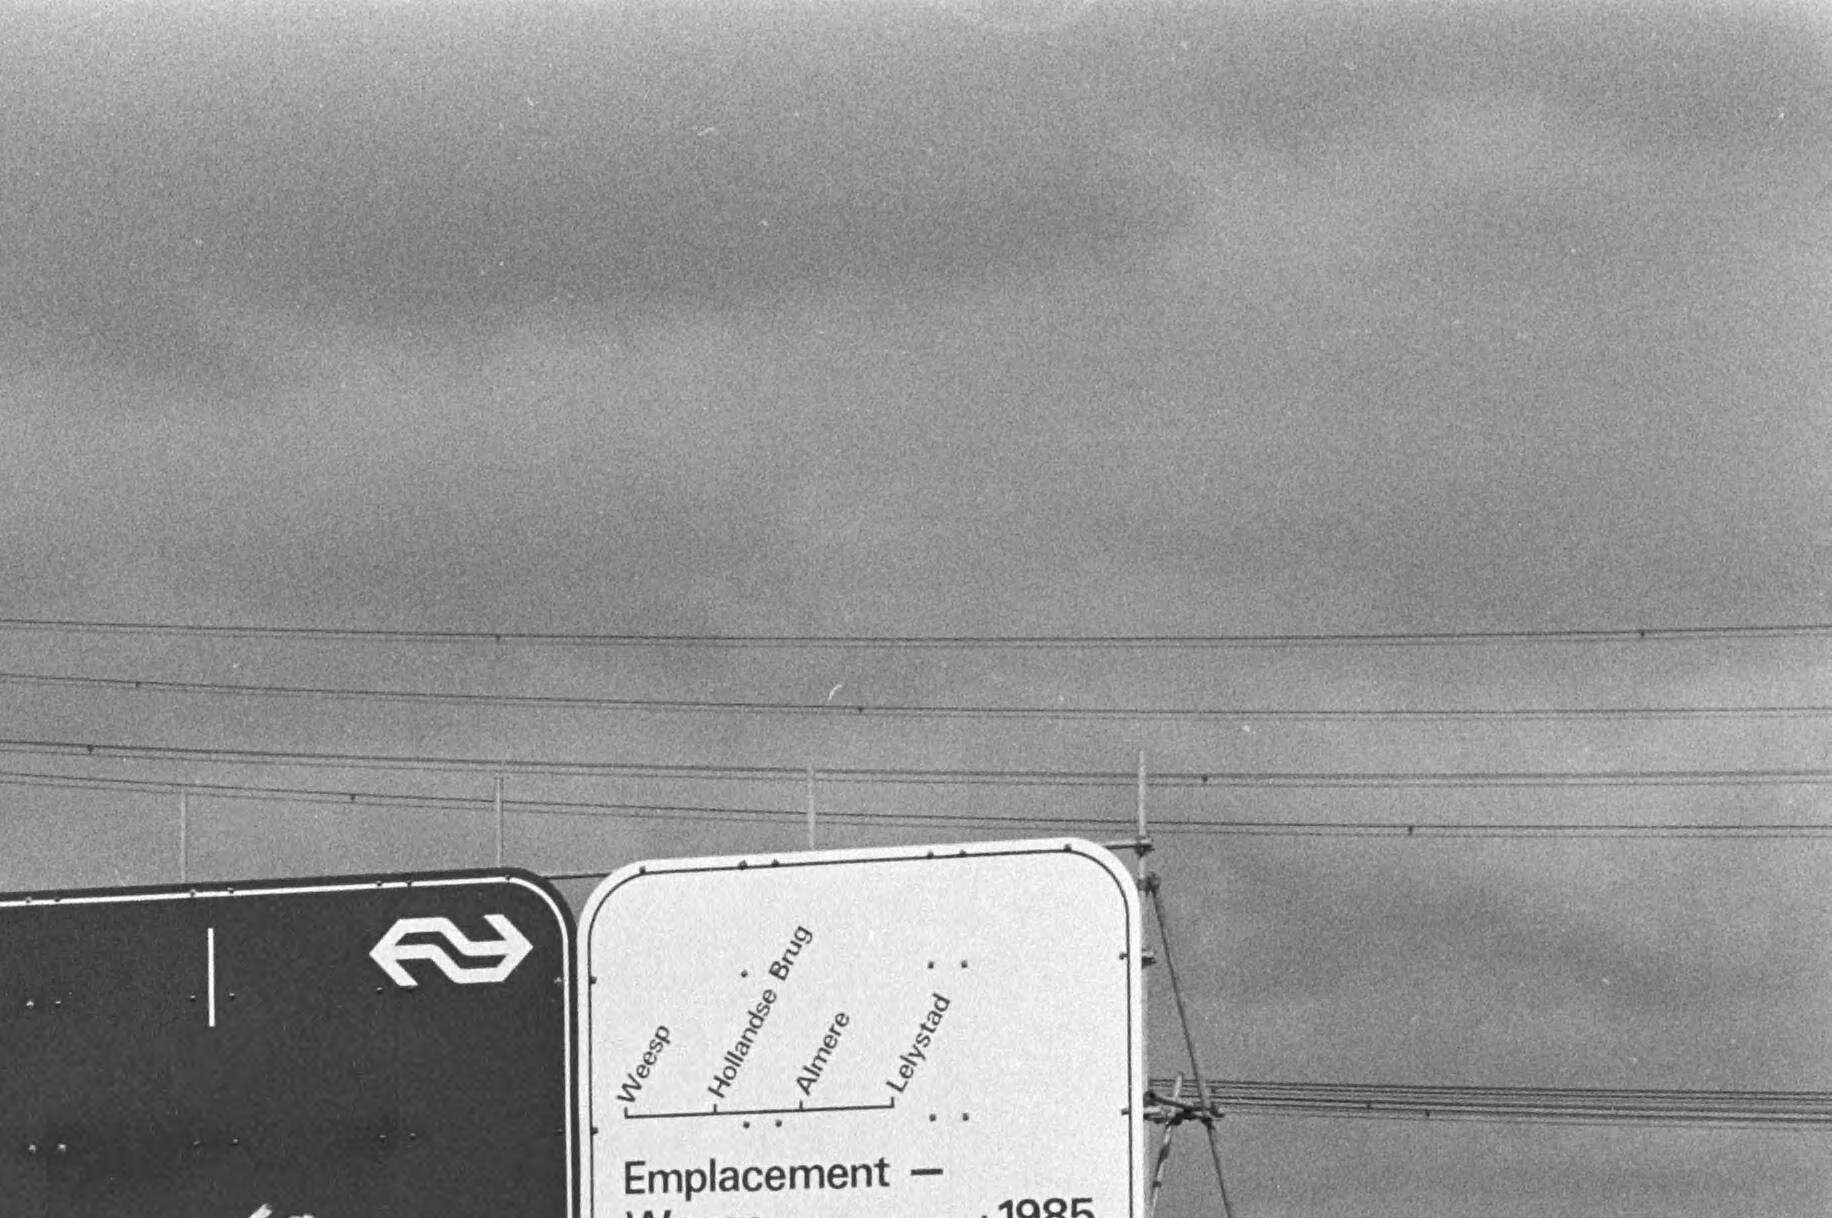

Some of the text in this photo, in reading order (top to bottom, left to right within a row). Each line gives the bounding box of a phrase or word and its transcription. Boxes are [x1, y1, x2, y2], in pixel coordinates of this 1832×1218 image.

[707, 925, 814, 1098] Hollandse Brug
[796, 1011, 850, 1096] Almere
[885, 992, 951, 1093] Lelystad
[616, 1023, 671, 1104] Weesp
[624, 1157, 890, 1202] Emplacement
